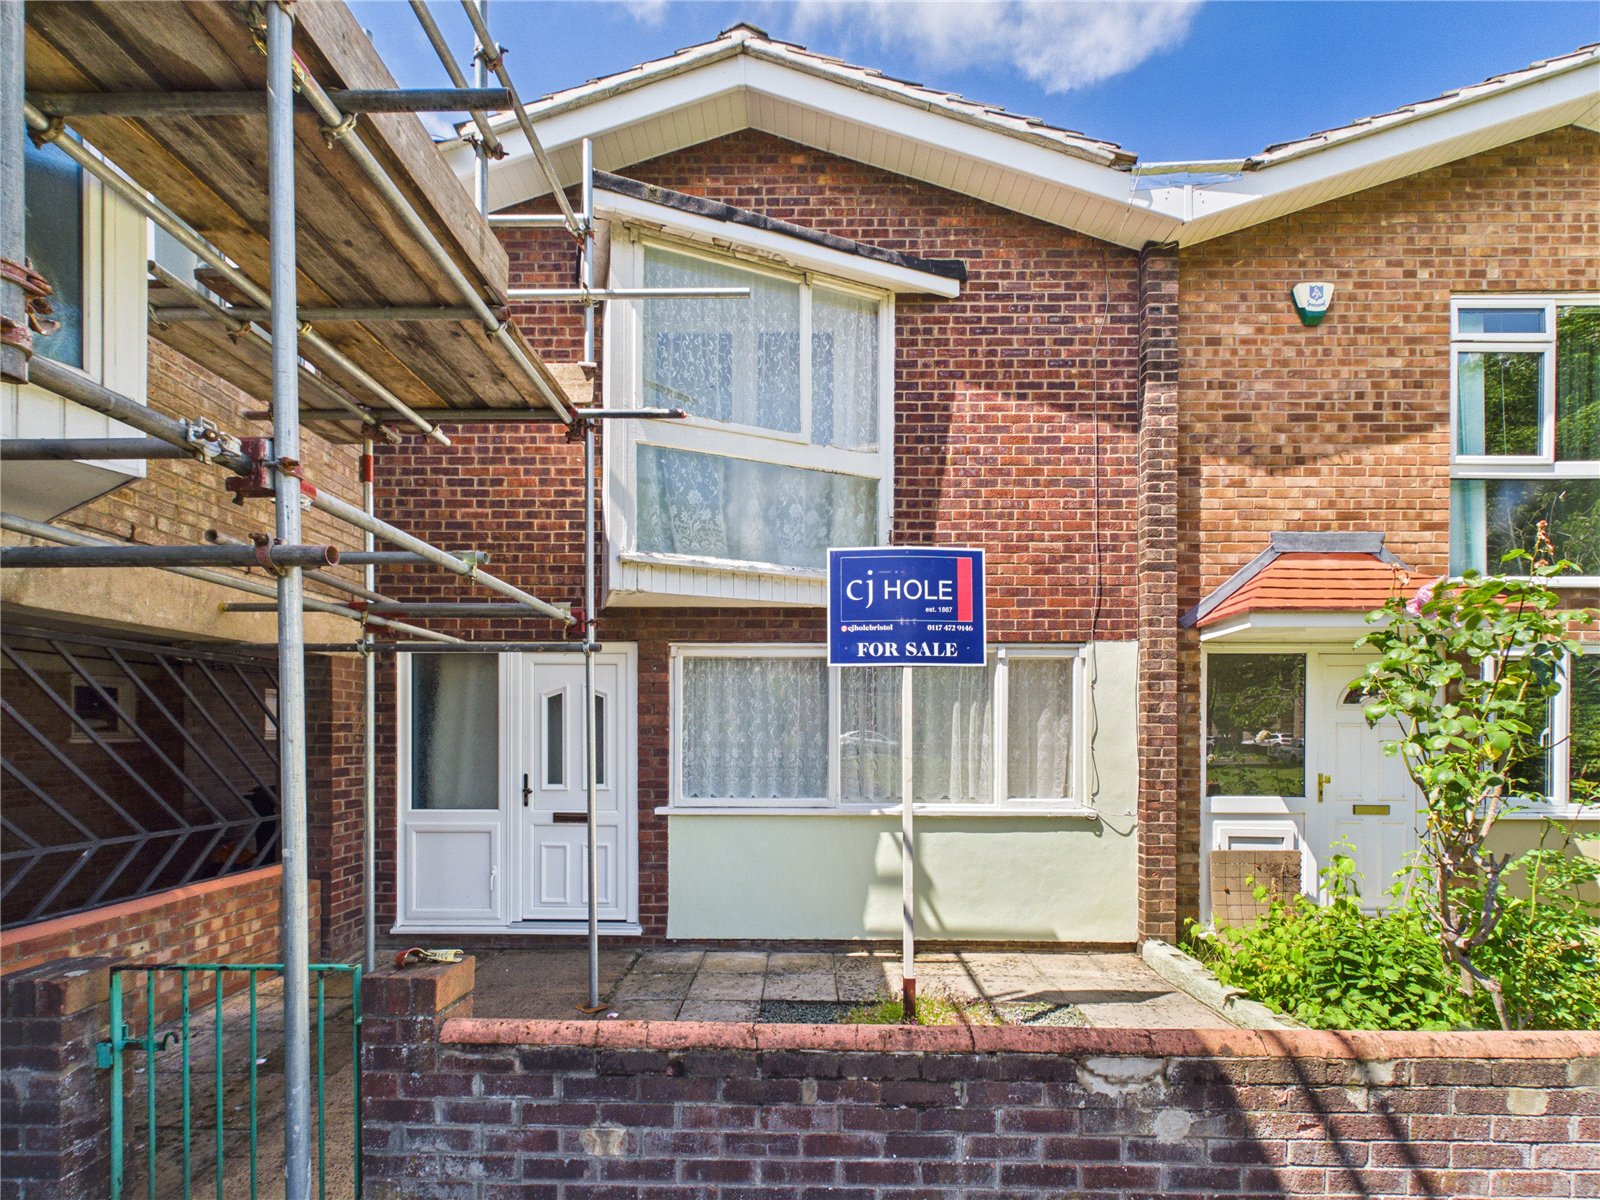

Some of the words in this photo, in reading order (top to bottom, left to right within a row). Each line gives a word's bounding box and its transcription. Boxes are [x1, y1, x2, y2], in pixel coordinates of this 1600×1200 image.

[884, 579, 953, 600] HOLE
[957, 624, 973, 632] 9146
[857, 642, 900, 657] FOR
[905, 641, 958, 657] SALE
